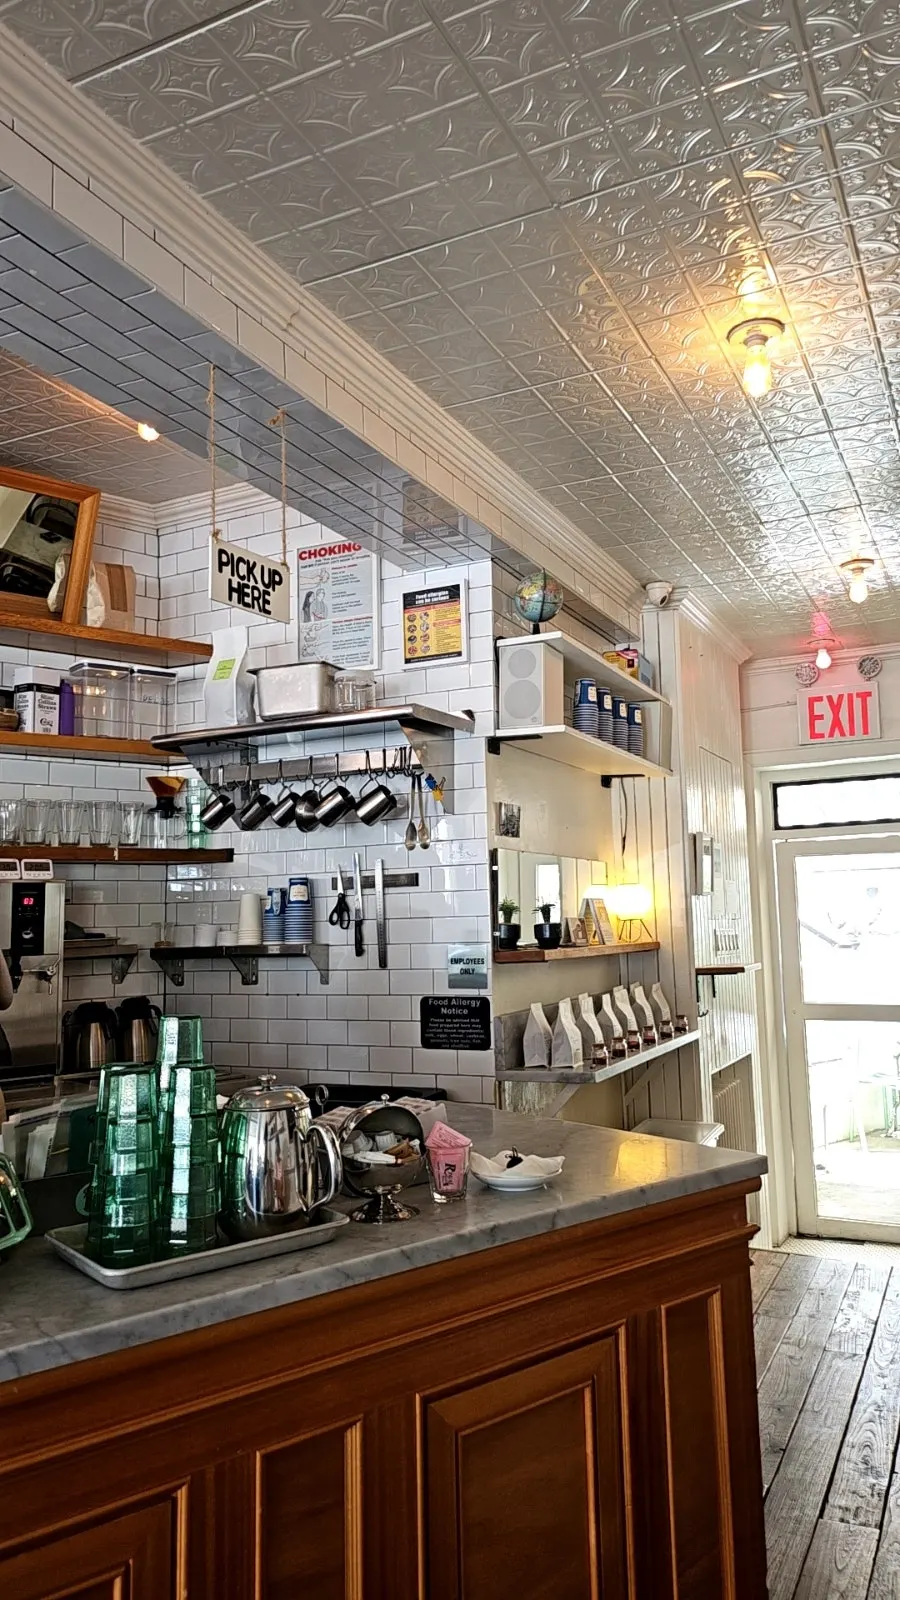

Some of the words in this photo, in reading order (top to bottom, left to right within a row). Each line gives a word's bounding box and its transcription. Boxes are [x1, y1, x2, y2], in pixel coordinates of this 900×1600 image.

[217, 548, 258, 585] PICK
[260, 564, 283, 592] UP
[298, 541, 362, 561] CHOKING
[228, 578, 272, 616] HERE
[807, 691, 873, 740] EXIT
[451, 998, 480, 1007] Allergy
